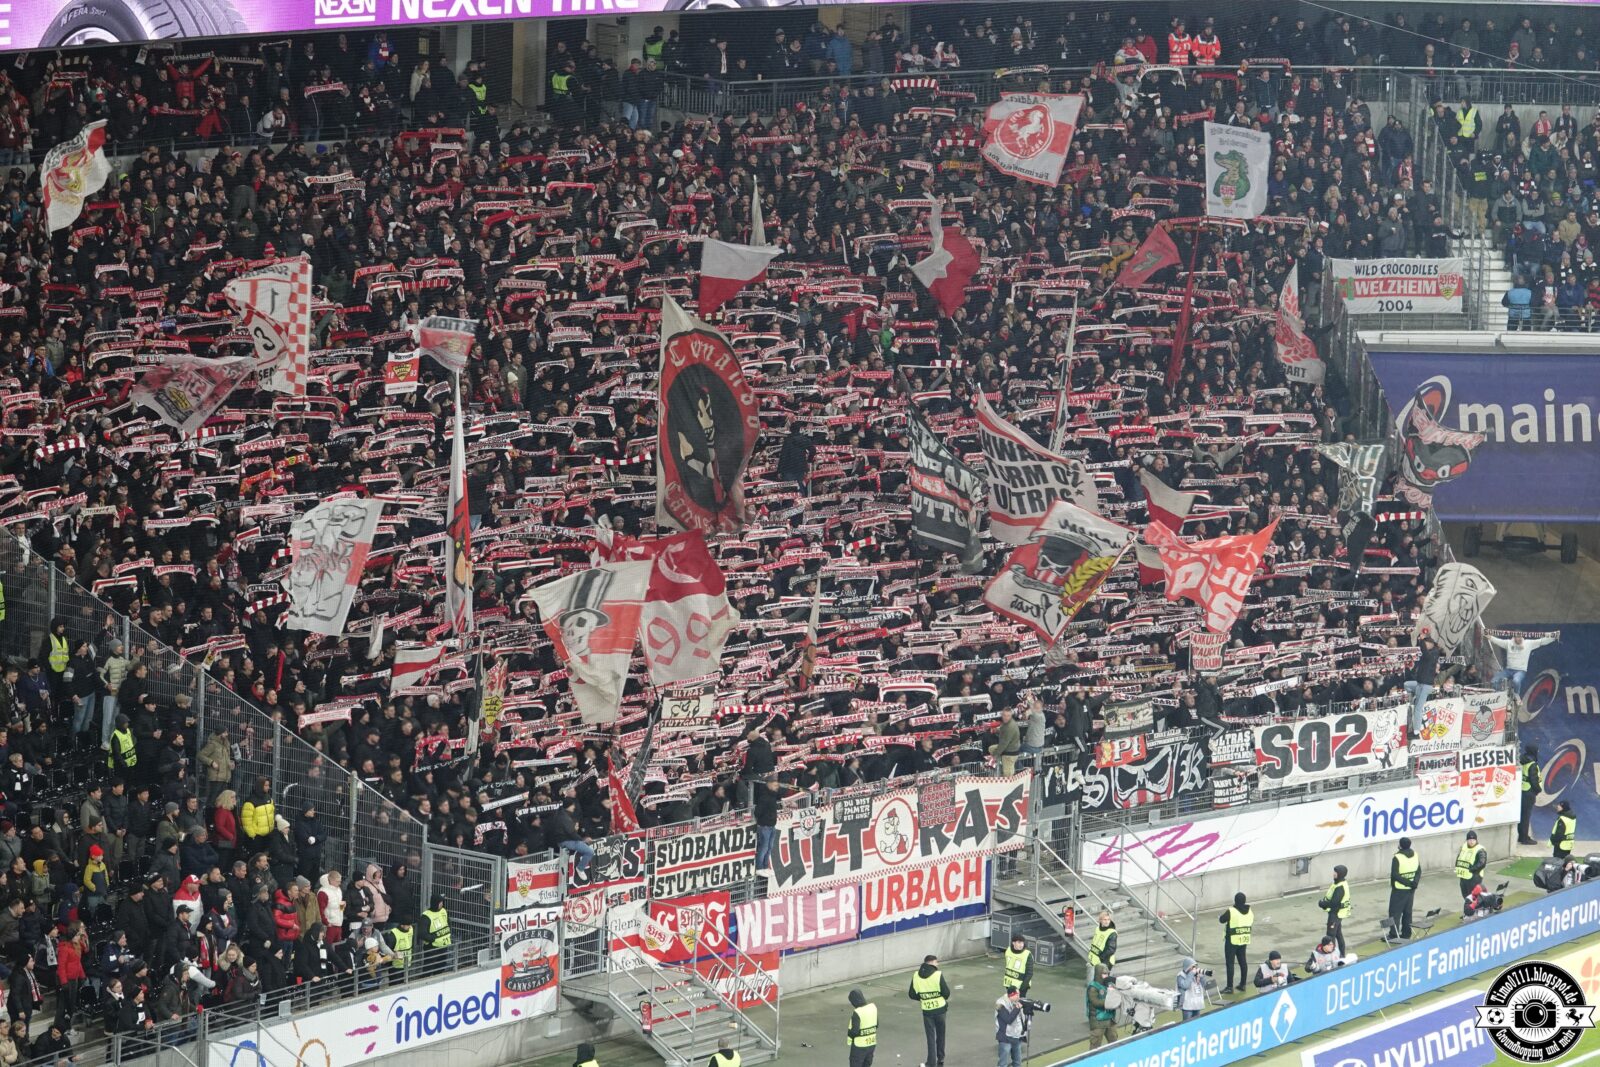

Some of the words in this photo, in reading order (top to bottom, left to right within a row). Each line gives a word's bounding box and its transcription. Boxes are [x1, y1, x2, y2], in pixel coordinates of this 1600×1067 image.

[1355, 264, 1377, 275] WILD
[1380, 263, 1438, 275] CROCODILES
[1355, 279, 1437, 295] WELZHEIM
[1378, 300, 1413, 312] 2004
[1458, 388, 1600, 442] main
[672, 688, 704, 698] ULTRAS
[660, 718, 708, 728] STUTTGART
[1215, 730, 1251, 746] LTRAS
[1462, 749, 1514, 770] HESSEN
[656, 825, 756, 868] SÜDBANDE
[654, 860, 755, 898] STUTTGART
[865, 856, 982, 922] URBACH
[735, 886, 857, 950] WEILER
[1326, 954, 1422, 1017] DEUTSCHE
[395, 978, 500, 1044] indeed
